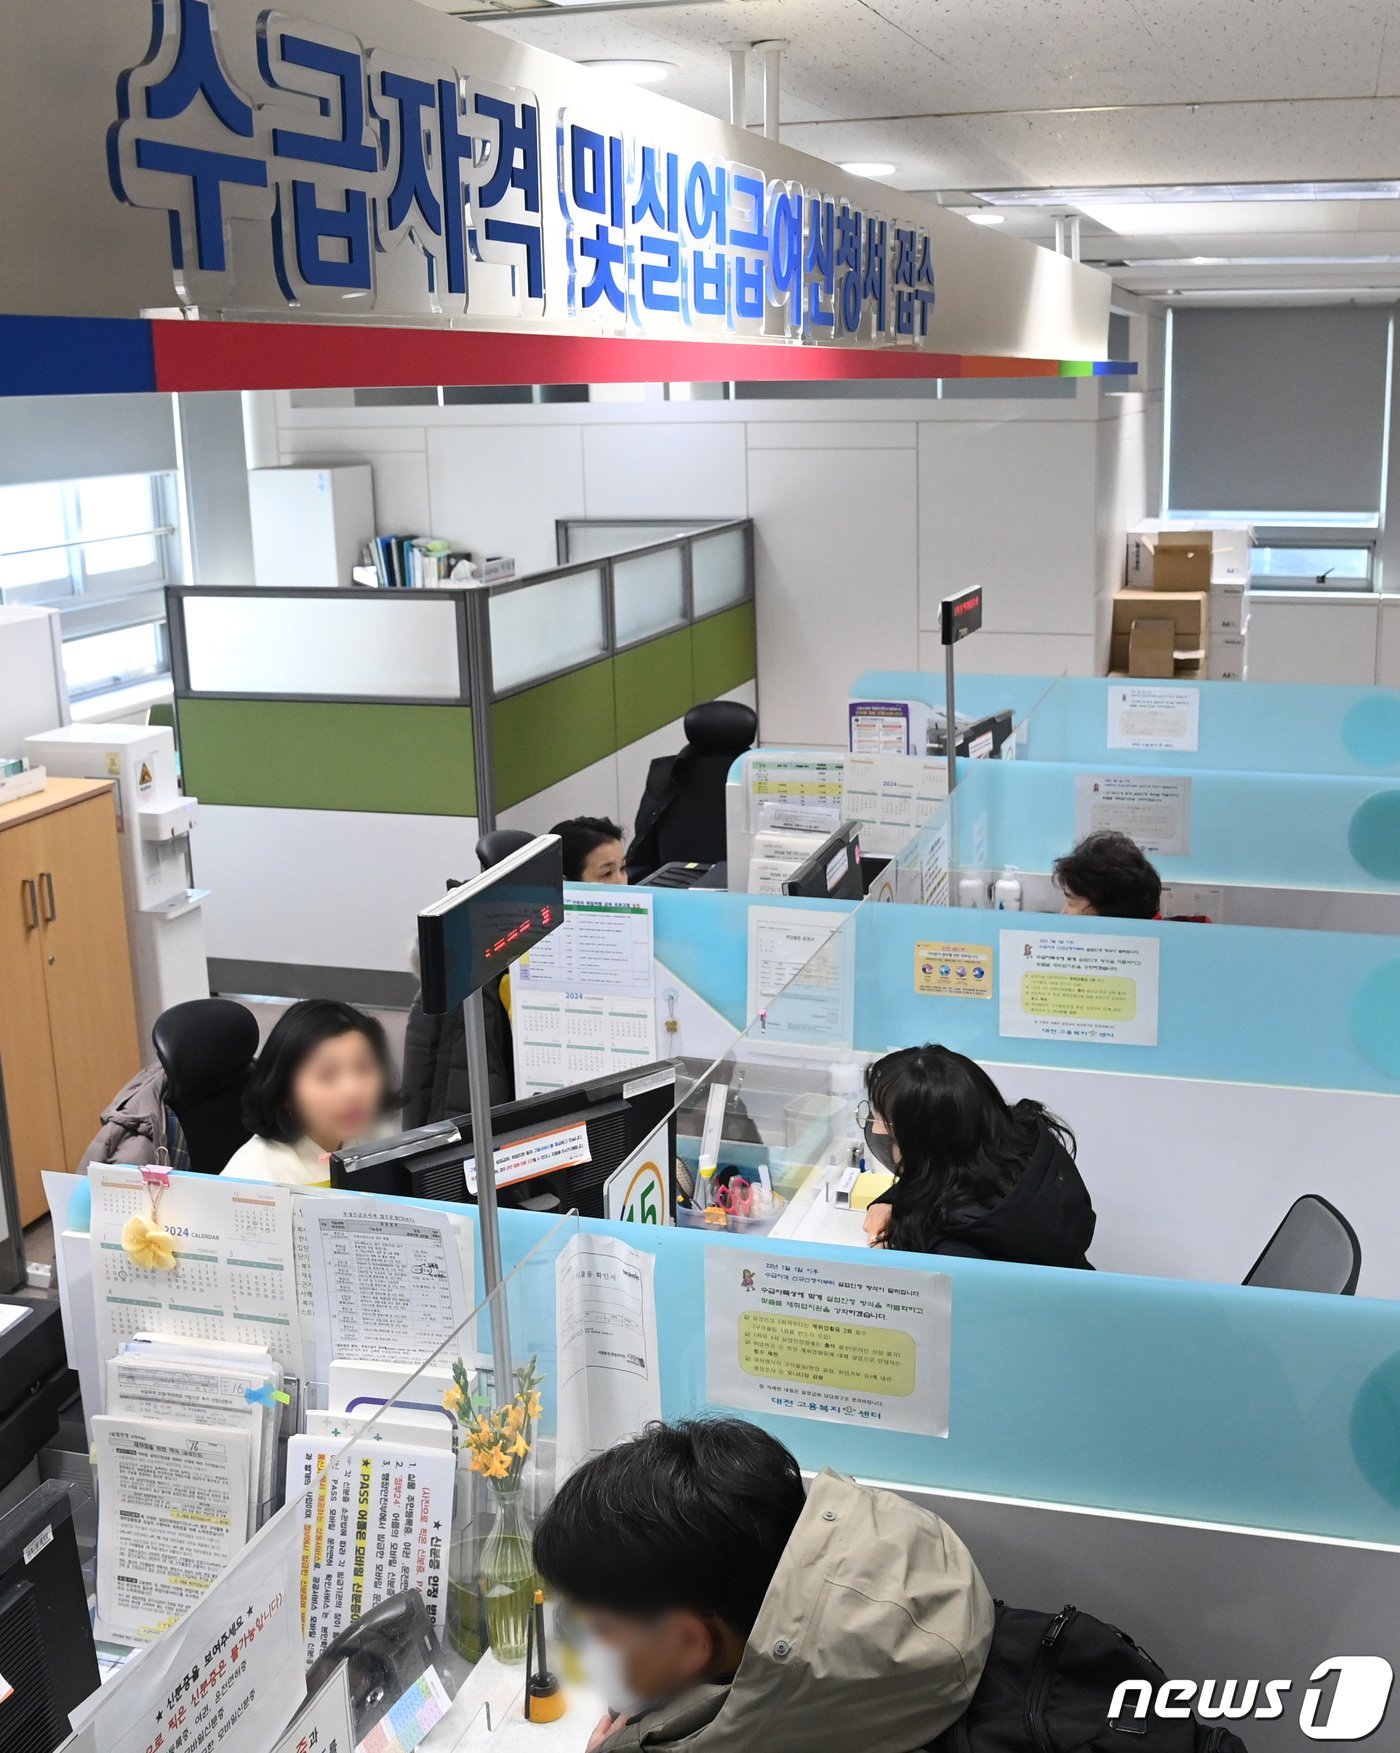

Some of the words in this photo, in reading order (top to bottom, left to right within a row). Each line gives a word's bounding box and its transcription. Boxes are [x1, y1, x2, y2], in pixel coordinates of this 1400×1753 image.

[133, 0, 545, 299] 수급자격
[565, 992, 583, 1000] 2024
[191, 1232, 219, 1240] CALENDAR
[827, 1294, 855, 1305] 실업인정
[771, 1397, 794, 1408] 대전
[858, 1409, 881, 1419] 센터
[304, 1452, 312, 1460] 과
[344, 1470, 352, 1478] 각
[406, 1473, 416, 1490] 실물
[341, 1482, 351, 1503] 신분증
[358, 1473, 370, 1505] PASS
[377, 1473, 390, 1530] 행정안전부에서
[420, 1487, 432, 1523] (사진으로
[327, 1508, 337, 1531] 모바일
[339, 1507, 350, 1536] 소관법에
[356, 1510, 368, 1541] 어플은
[390, 1512, 401, 1537] 어플의
[338, 1540, 348, 1555] 따라
[376, 1534, 387, 1559] 발급한
[418, 1528, 428, 1544] 찍은
[325, 1537, 336, 1567] 운전면허
[353, 1545, 366, 1577] 모바일
[388, 1542, 399, 1568] 모바일
[402, 1542, 413, 1558] 여권
[429, 1536, 442, 1570] 신분증
[338, 1560, 346, 1568] 각
[373, 1564, 385, 1589] 모바일
[310, 1576, 320, 1611] 공공서비스
[334, 1571, 345, 1609] 발급기관의
[427, 1575, 440, 1598] 인정
[308, 1616, 318, 1638] 모바일
[333, 1613, 343, 1627] 장이
[166, 1665, 200, 1710] 신분증을
[204, 1615, 245, 1668] 보여주세요
[214, 1659, 248, 1705] 운전면허증
[168, 1705, 187, 1731] 찍은
[190, 1659, 227, 1708] 신분증은
[217, 1688, 256, 1742] 모바일신분증
